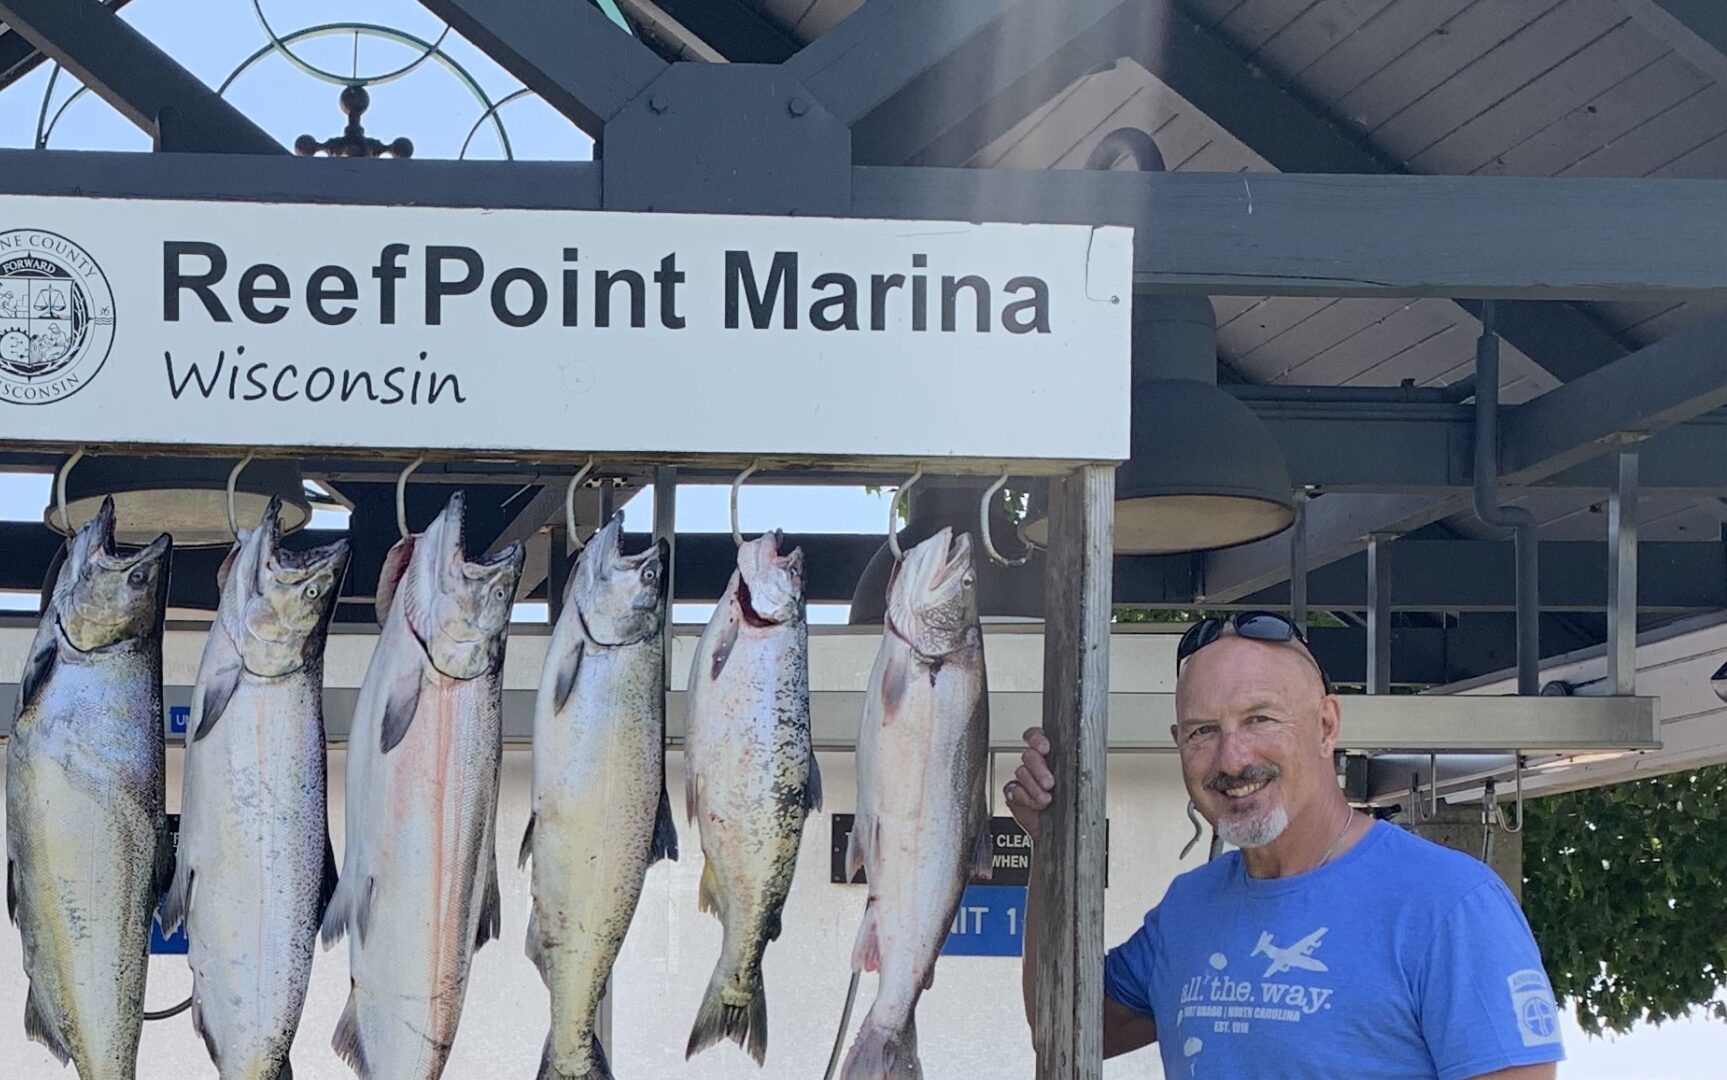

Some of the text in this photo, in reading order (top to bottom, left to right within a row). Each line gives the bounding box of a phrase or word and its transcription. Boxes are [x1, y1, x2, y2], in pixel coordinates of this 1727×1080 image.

[2, 258, 57, 274] FORWARD
[29, 234, 98, 279] COUNTY
[163, 240, 1053, 335] ReefPoint Marina
[164, 346, 467, 405] Wisconsin
[992, 855, 1028, 868] WHEN
[1210, 975, 1255, 1002] the.
[1261, 982, 1334, 1014] way.
[1214, 1021, 1231, 1033] EST.
[1227, 1006, 1254, 1018] NORTH
[1254, 1007, 1301, 1022] CAROLINA
